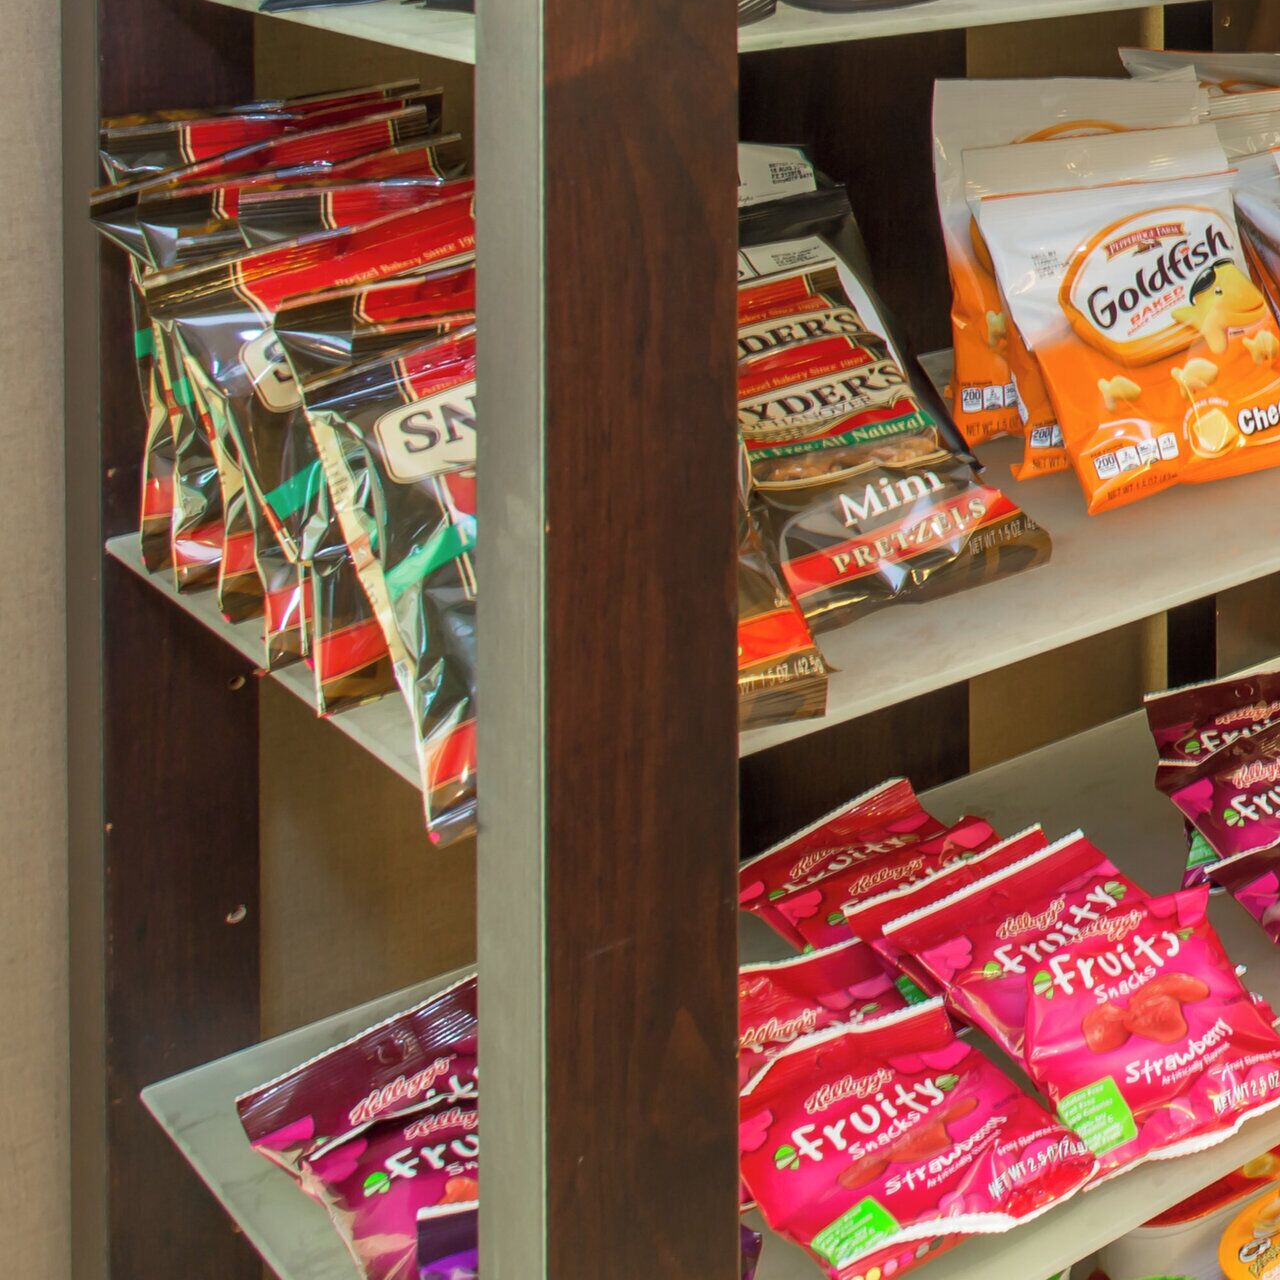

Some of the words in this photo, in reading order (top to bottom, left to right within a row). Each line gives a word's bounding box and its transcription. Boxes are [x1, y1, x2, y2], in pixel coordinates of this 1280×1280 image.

[380, 256, 423, 274] Bakery
[422, 244, 457, 260] Since
[1107, 231, 1154, 255] PEPPERIDGE
[1153, 223, 1186, 239] FARM
[1087, 224, 1233, 330] Goldfish
[1129, 285, 1186, 326] BAKED
[808, 361, 837, 378] Since
[771, 395, 871, 429] HANOVER
[962, 389, 982, 403] 200
[853, 410, 928, 441] Natural
[1032, 427, 1051, 440] 200
[1096, 454, 1116, 469] 200
[829, 496, 989, 576] PRETZELS
[993, 884, 1118, 974] Fruity
[996, 892, 1067, 940] Kellogg's
[1048, 930, 1181, 996] Fruity
[1093, 964, 1157, 1005] Snacks
[1125, 1016, 1234, 1085] Strawberry
[348, 1056, 451, 1127] Kellogg's
[803, 1067, 896, 1115] Kellogg's
[1212, 1092, 1232, 1114] NET
[1232, 1084, 1250, 1102] WT
[1267, 1074, 1280, 1090] OZ
[790, 1075, 946, 1163] Fruity
[847, 1110, 921, 1162] Snacks
[1008, 1163, 1027, 1184] WT
